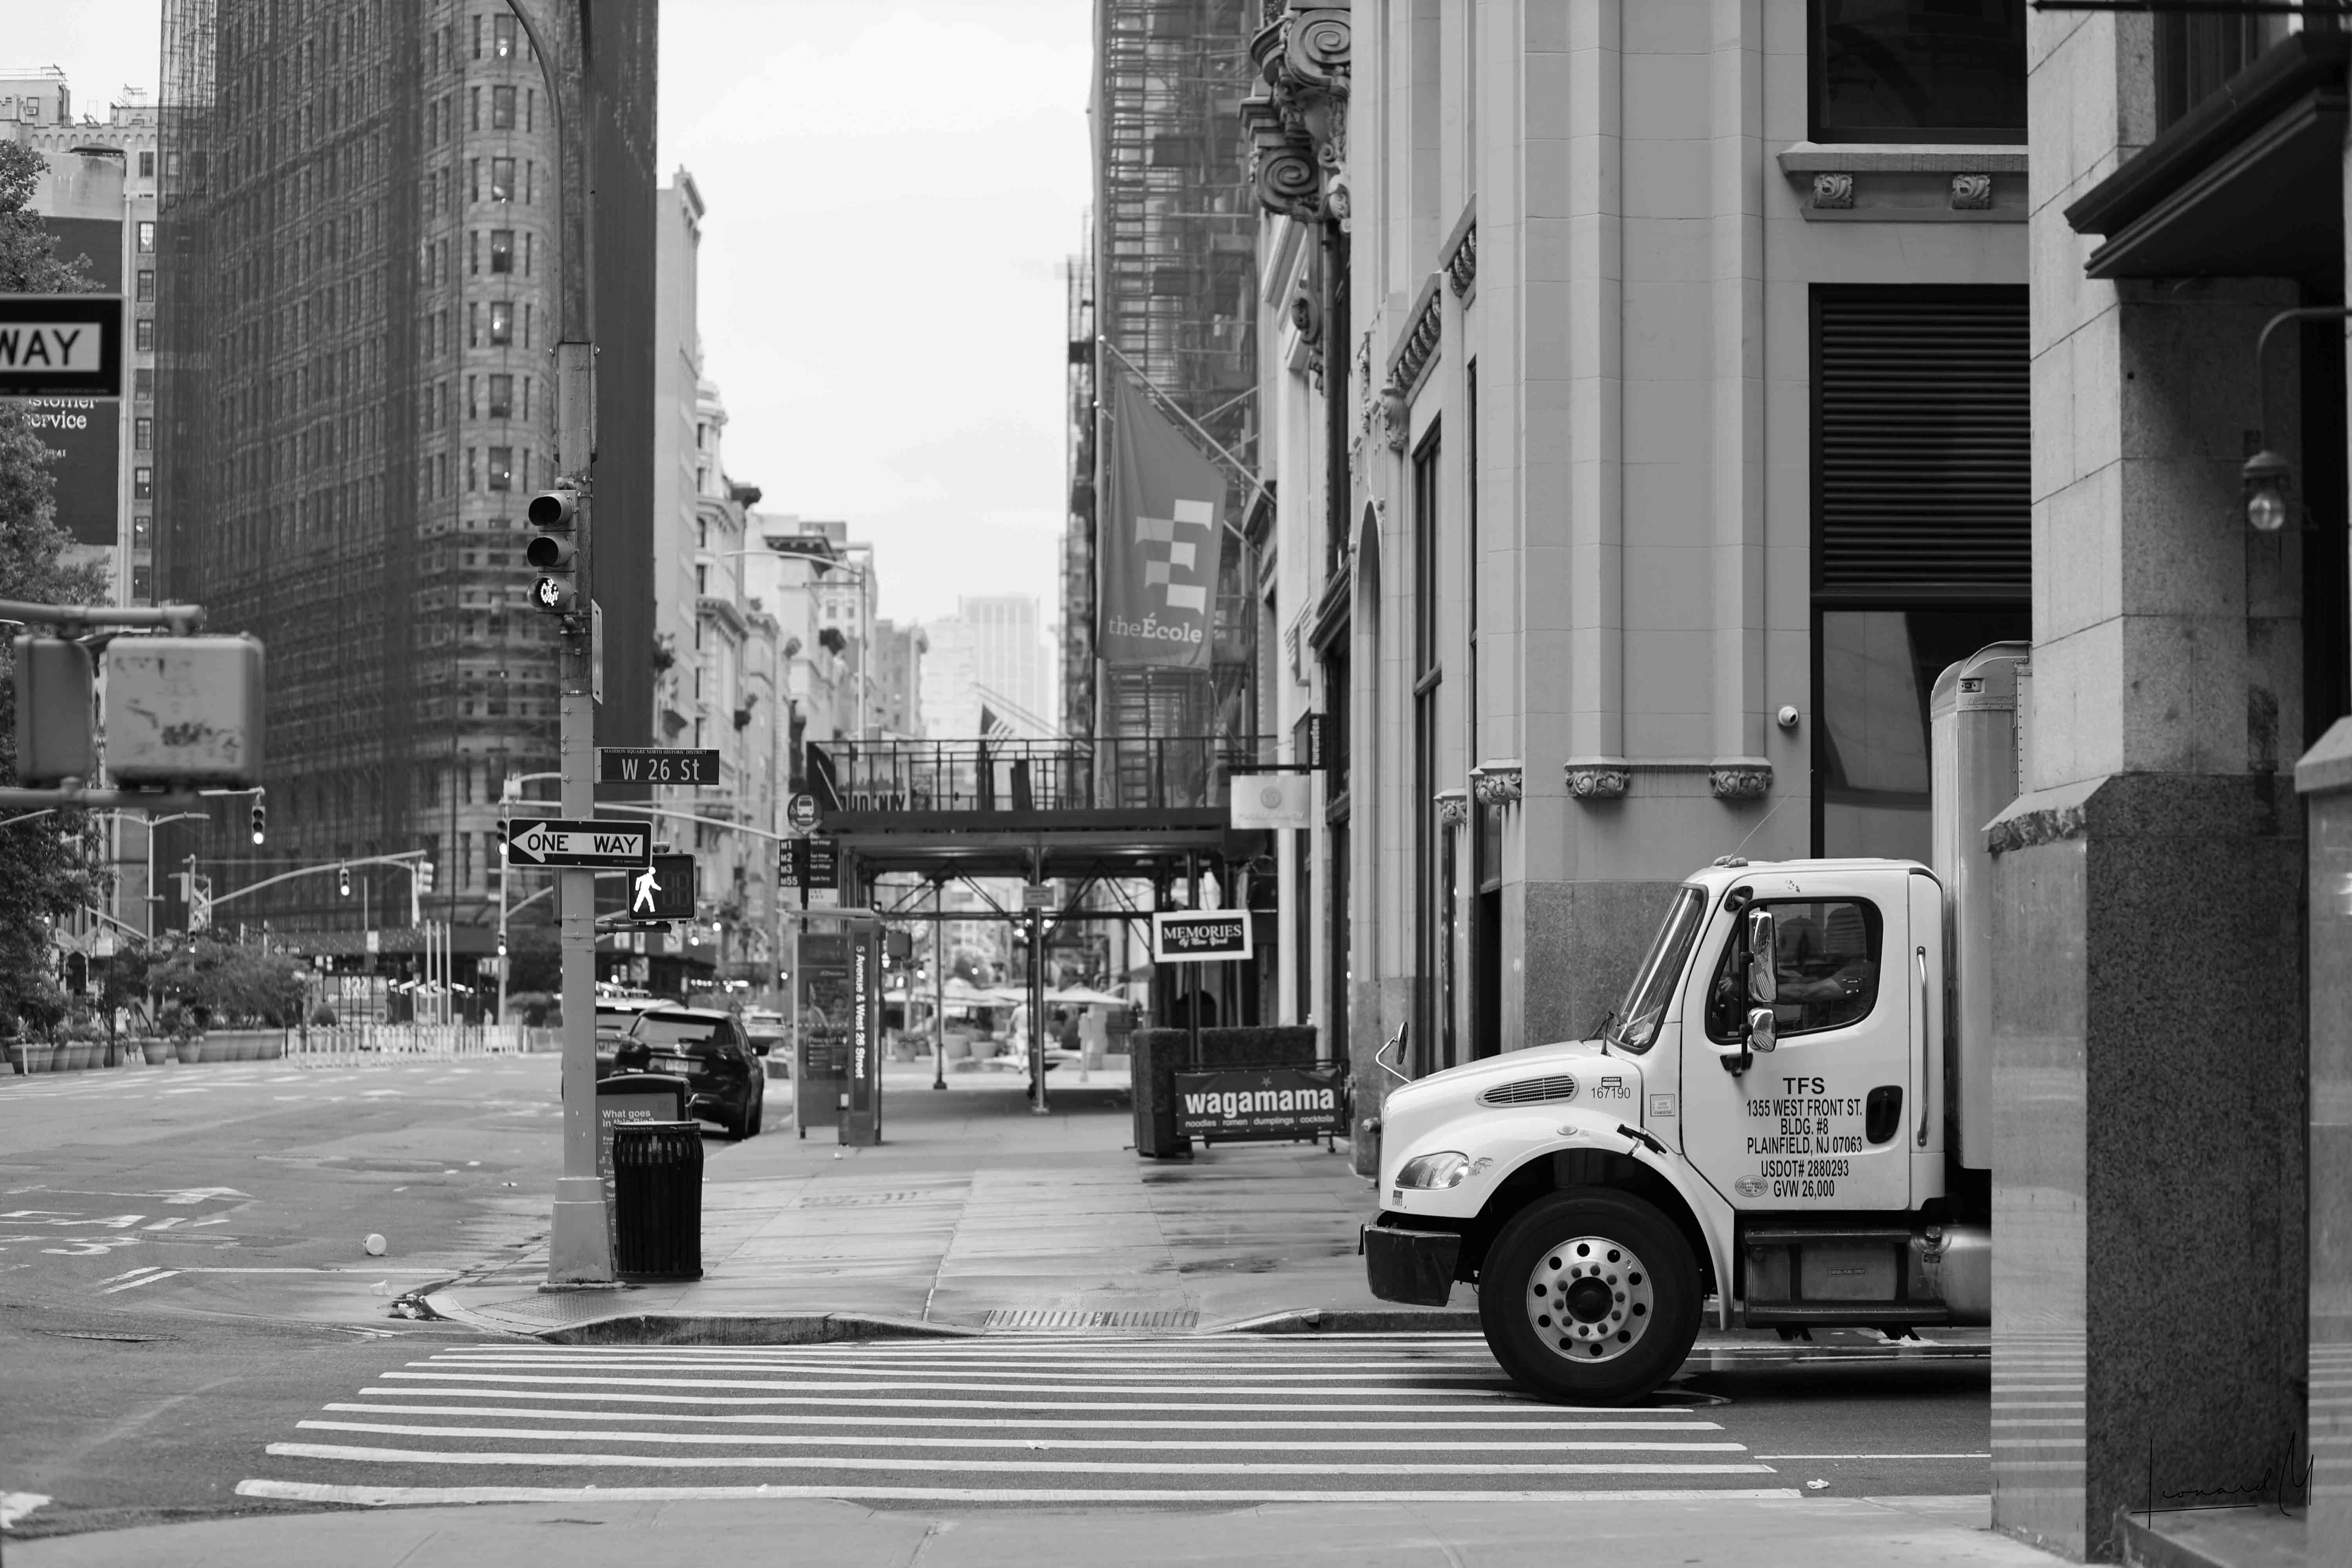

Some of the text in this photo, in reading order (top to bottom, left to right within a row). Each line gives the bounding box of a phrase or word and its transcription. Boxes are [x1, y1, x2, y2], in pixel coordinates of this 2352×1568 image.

[0, 328, 81, 366] WAY
[1109, 612, 1203, 644] theÉcole
[622, 759, 699, 780] W 26 St
[528, 834, 639, 854] ONE WAY
[780, 840, 792, 850] M1
[780, 852, 793, 862] M2
[780, 864, 793, 873] M3
[780, 876, 798, 886] M55
[1163, 924, 1242, 940] MEMORIES
[856, 954, 865, 993] Avenue
[856, 994, 865, 1002] &
[856, 1004, 865, 1031] West
[855, 1032, 866, 1046] 26
[855, 1047, 866, 1079] Street
[1591, 1087, 1631, 1098] 167190
[1782, 1077, 1825, 1094] TFS
[1185, 1089, 1335, 1118] wagamama
[1747, 1099, 1862, 1116] 1355 WEST FRONT ST.
[602, 1109, 651, 1119] What goes
[1185, 1119, 1216, 1127] noodles
[1254, 1116, 1294, 1126] dumplings
[1299, 1114, 1334, 1123] cocktails
[1781, 1117, 1828, 1135] BLDG. #8
[1748, 1136, 1862, 1157] PLAINFIELD, NJ 07063
[1761, 1160, 1849, 1177] USDOT# 2880293
[1774, 1180, 1835, 1200] GVW 26,000
